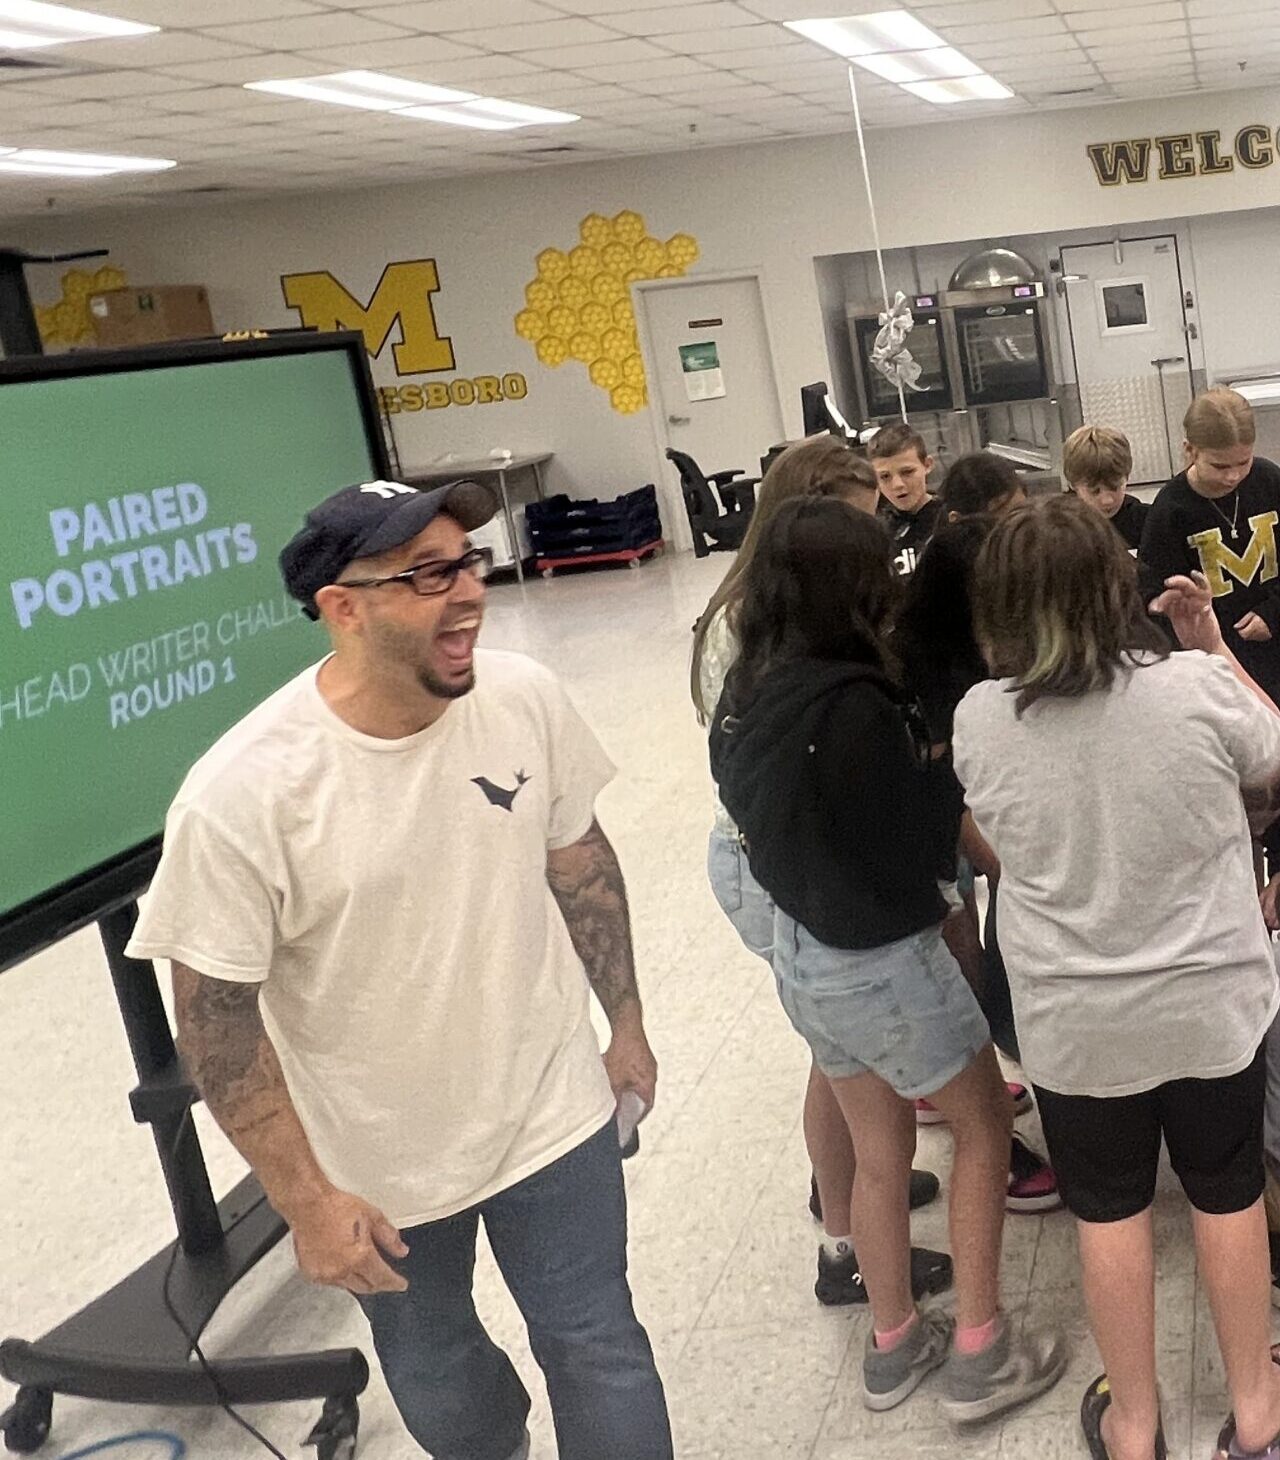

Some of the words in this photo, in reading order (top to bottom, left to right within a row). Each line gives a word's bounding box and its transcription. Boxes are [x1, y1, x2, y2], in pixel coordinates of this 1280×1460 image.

[281, 258, 456, 376] M
[50, 483, 208, 557] PAIRED
[1187, 511, 1279, 598] M
[10, 523, 257, 629] PORTRAITS
[0, 664, 92, 727] HEAD
[97, 621, 210, 689] WRITER
[110, 660, 215, 729] ROUND
[221, 656, 236, 684] 1
